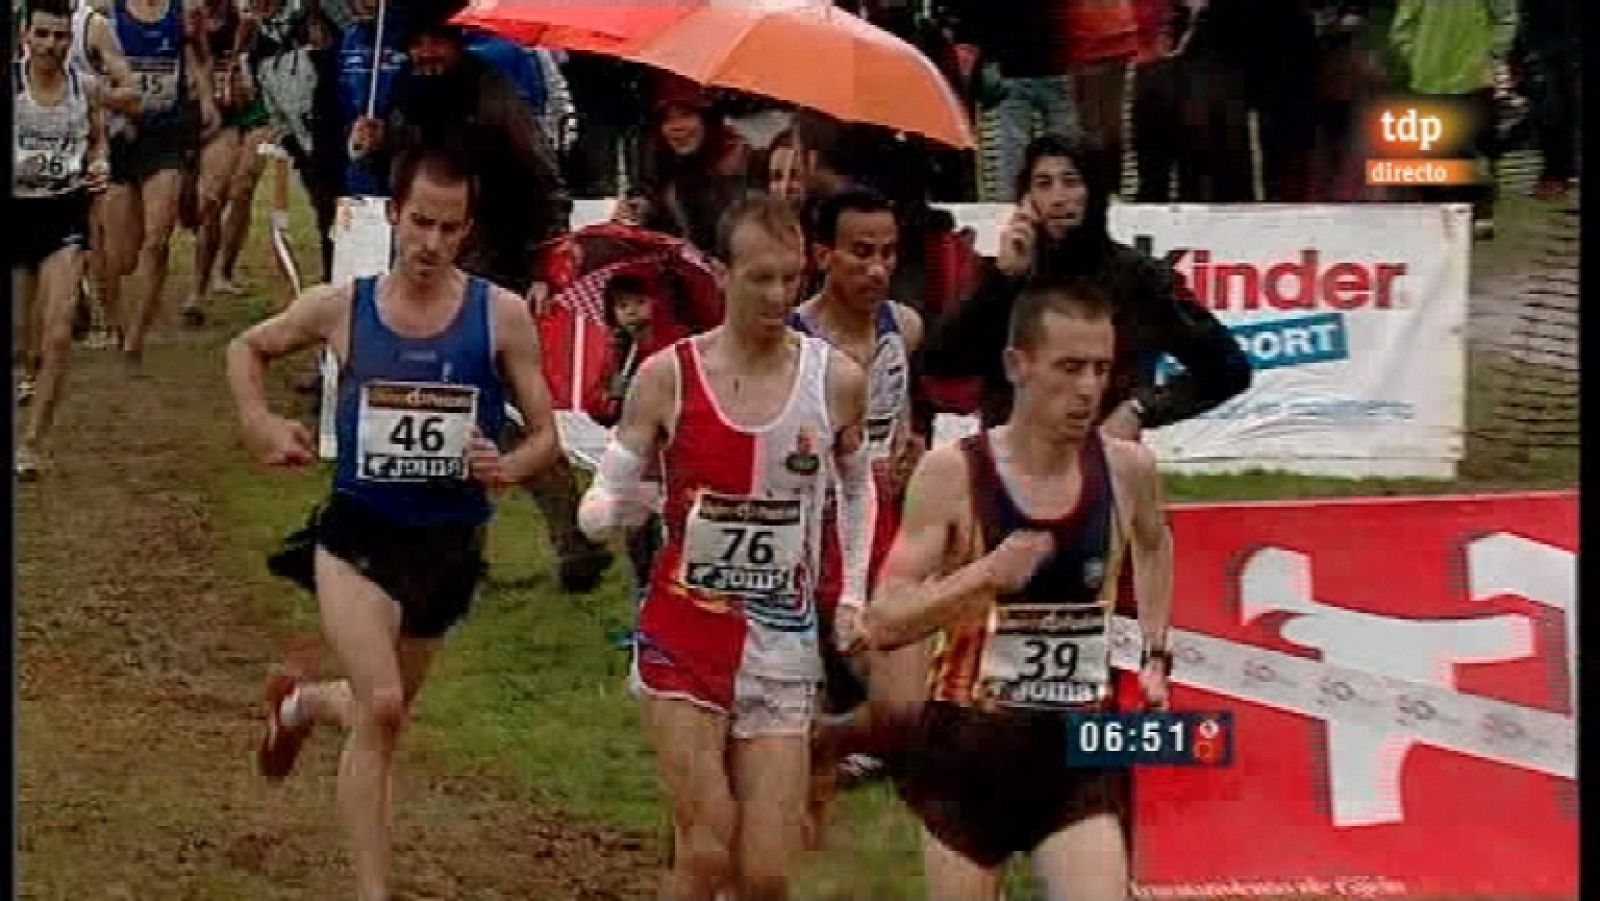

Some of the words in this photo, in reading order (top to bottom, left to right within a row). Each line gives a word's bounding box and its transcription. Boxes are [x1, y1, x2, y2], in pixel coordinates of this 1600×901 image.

[389, 415, 445, 452] 46
[719, 528, 775, 563] 76
[1018, 640, 1079, 680] 39
